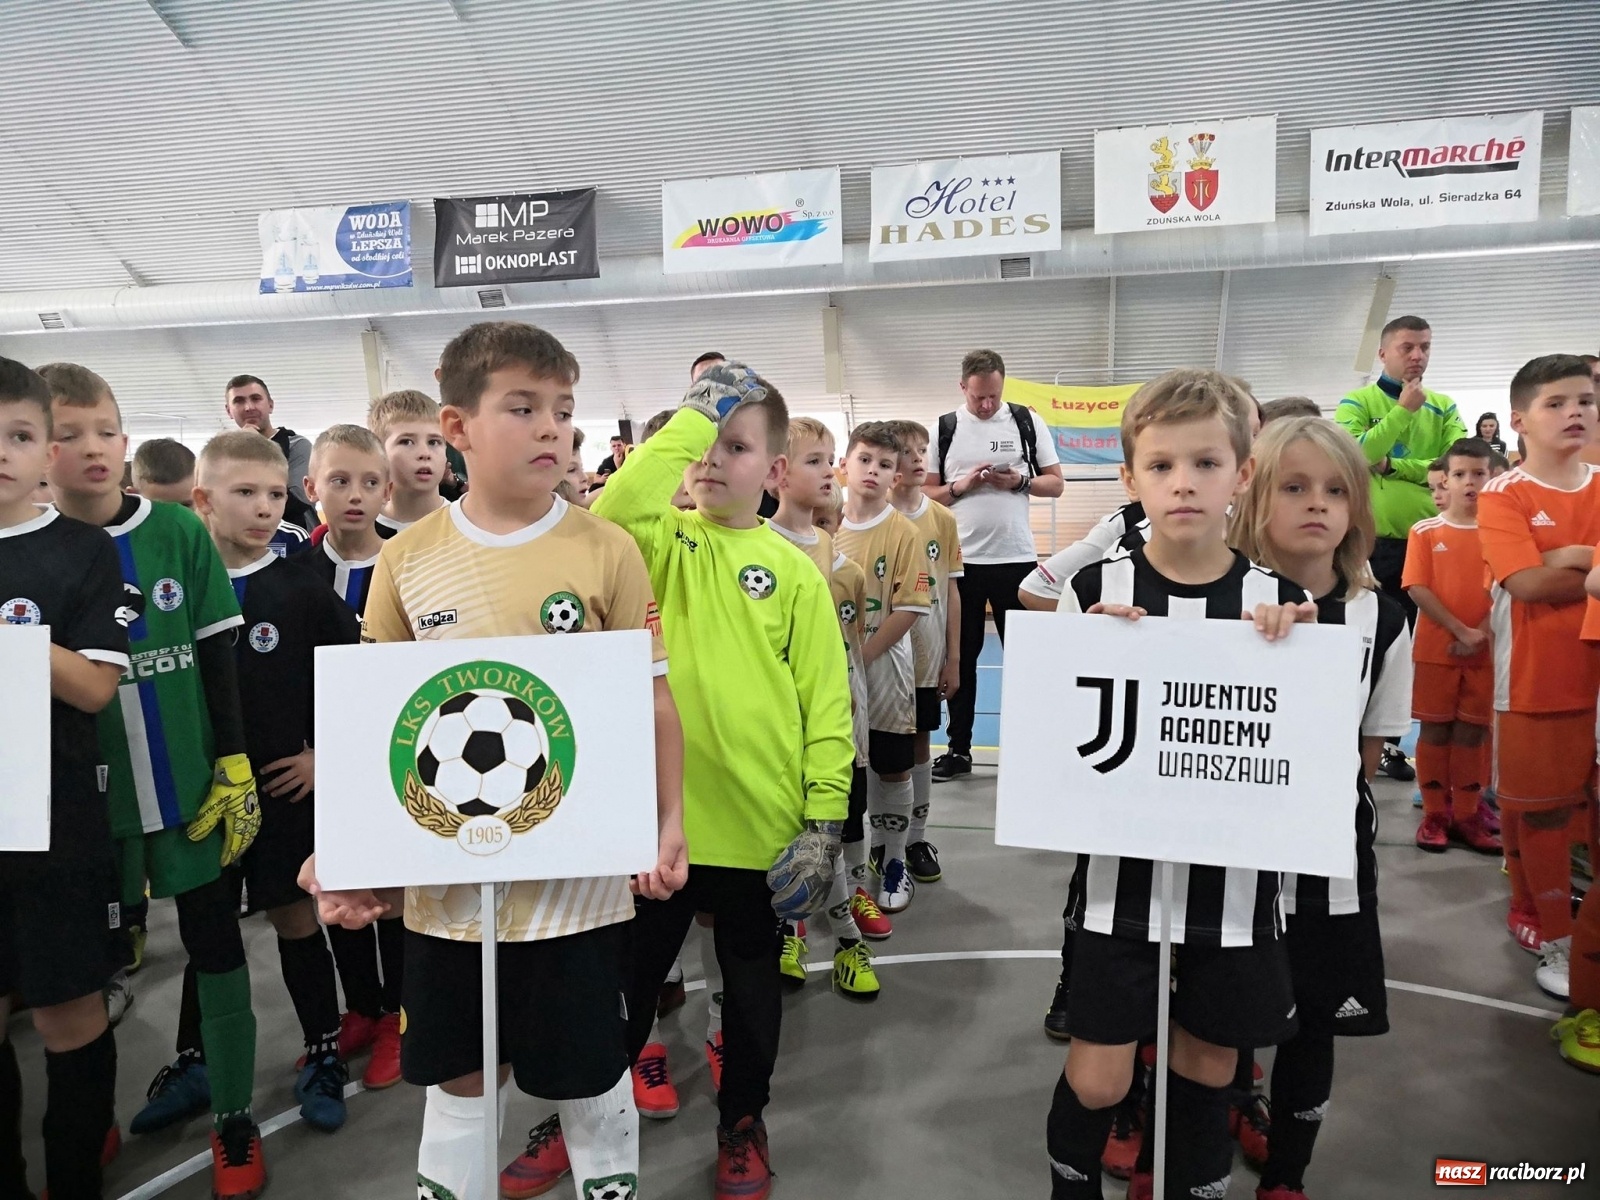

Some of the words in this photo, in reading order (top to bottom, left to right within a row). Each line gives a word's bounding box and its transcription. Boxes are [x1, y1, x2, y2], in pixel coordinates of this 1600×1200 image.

[905, 177, 1017, 219] Hotel
[1325, 200, 1376, 211] Zduńska
[1381, 197, 1414, 208] Wola,
[1419, 196, 1434, 205] ul.
[1439, 192, 1499, 203] Sieradzka
[1504, 189, 1522, 200] 64
[348, 211, 403, 231] WODA
[501, 200, 549, 228] MP
[698, 213, 784, 237] WOWO
[802, 209, 815, 219] Sp.
[1194, 213, 1221, 222] WOLA
[456, 231, 509, 245] Marek
[513, 228, 575, 241] Pazera
[880, 213, 1051, 244] HADES
[351, 237, 403, 252] LEPSZA
[351, 254, 361, 262] od
[485, 250, 578, 270] OKNOPLAST
[437, 666, 569, 739] TWORKÓW
[1161, 681, 1278, 713] JUVENTUS
[396, 696, 431, 747] LKS
[1160, 716, 1272, 748] ACADEMY
[1158, 751, 1290, 786] WARSZAWA
[466, 827, 503, 845] 1905
